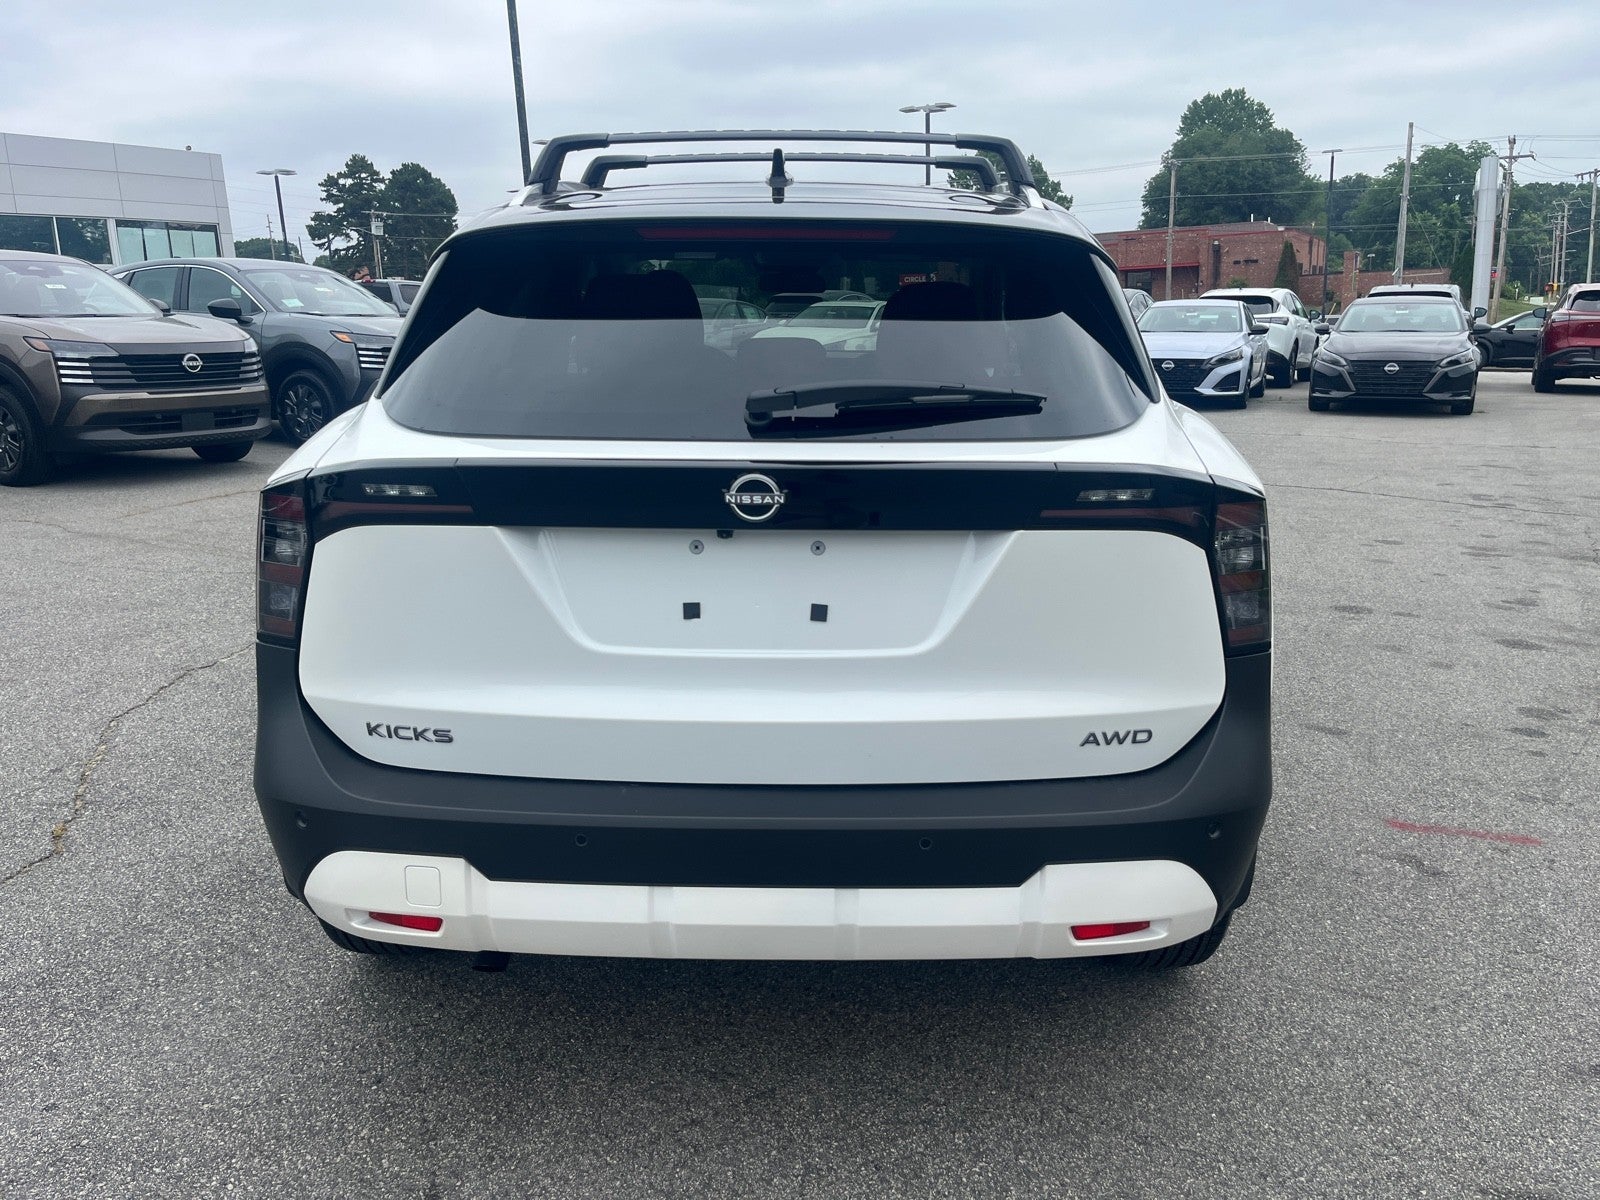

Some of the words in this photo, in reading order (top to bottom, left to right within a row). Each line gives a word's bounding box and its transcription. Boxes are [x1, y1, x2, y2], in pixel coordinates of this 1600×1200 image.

[725, 495, 784, 504] NISSAN
[366, 721, 453, 744] KICKS
[1079, 728, 1153, 747] AWD
